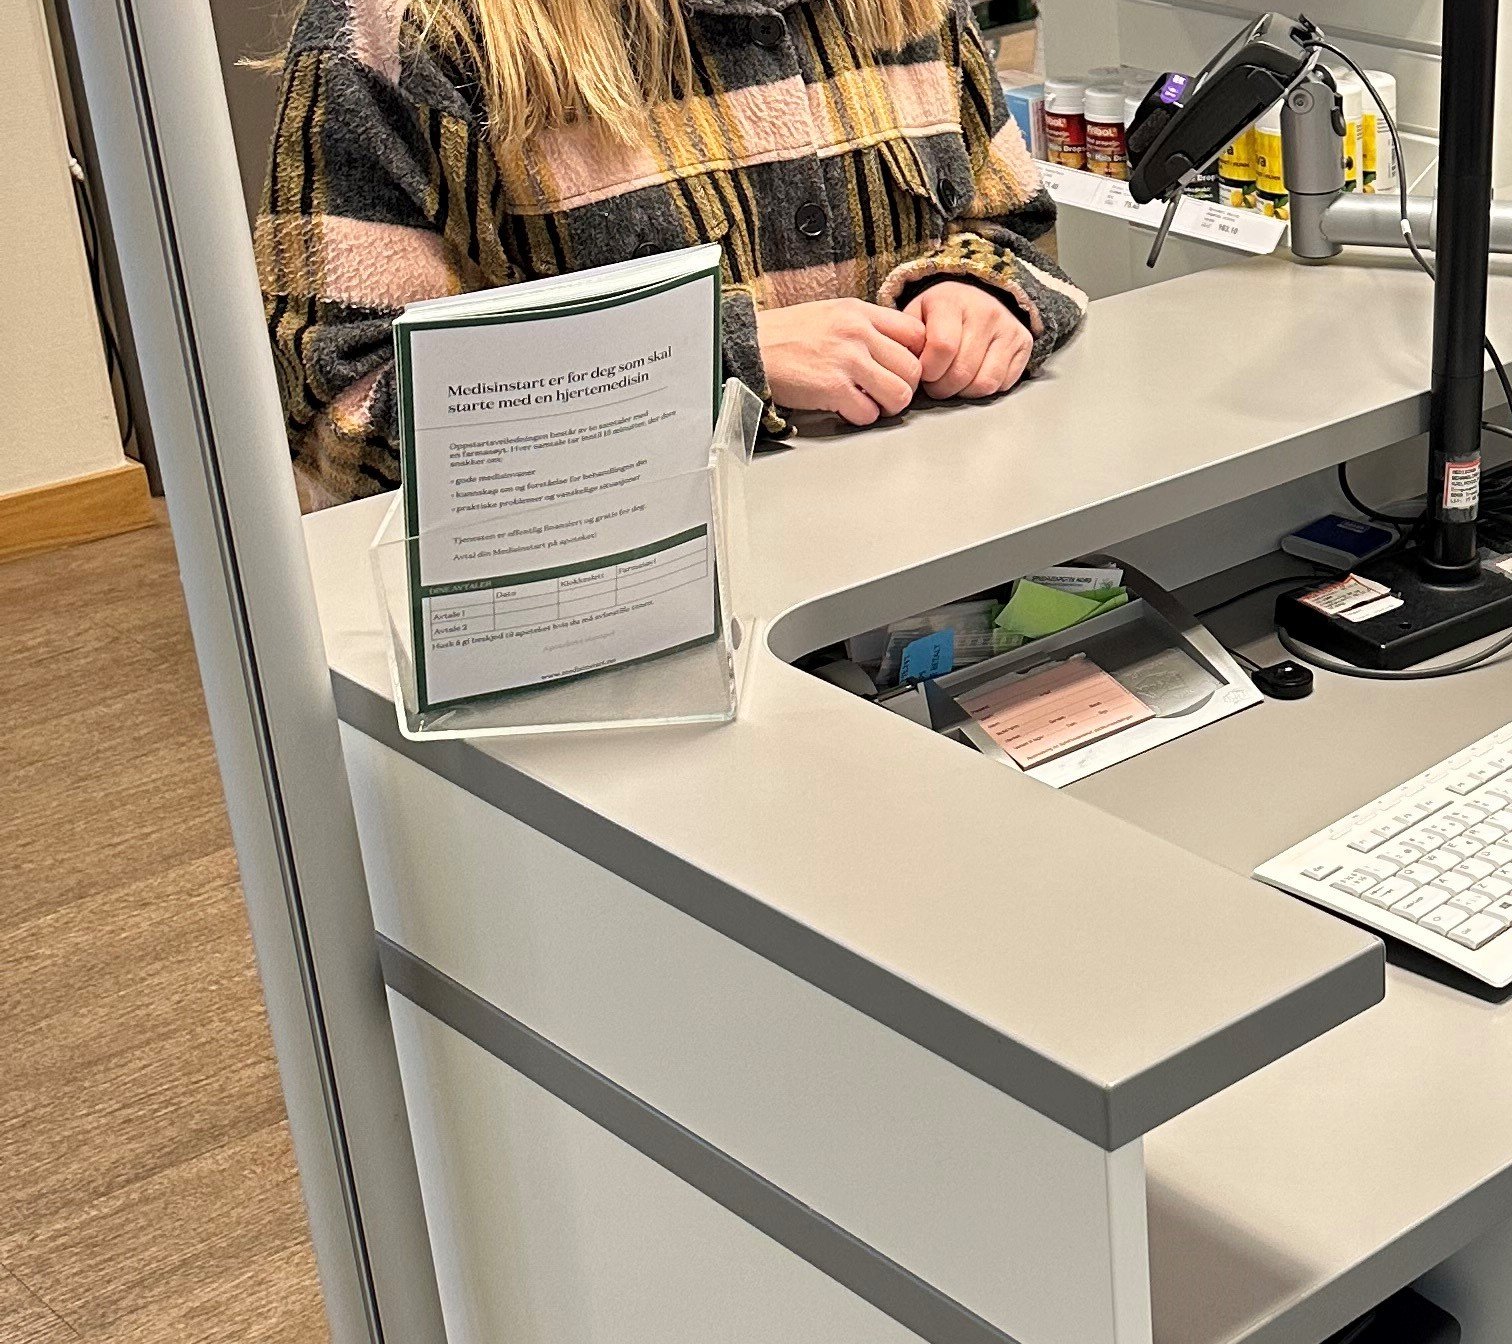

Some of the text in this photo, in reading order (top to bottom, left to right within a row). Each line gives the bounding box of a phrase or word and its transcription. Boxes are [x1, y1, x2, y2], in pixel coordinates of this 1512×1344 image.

[447, 346, 672, 398] Medisinstart er for deg som skal
[447, 372, 649, 414] starte med en hjertemedisin
[633, 410, 649, 421] med
[455, 476, 477, 485] gode
[569, 475, 581, 483] for
[544, 493, 555, 501] og
[619, 508, 630, 516] for
[477, 550, 490, 558] din
[547, 540, 558, 549] på
[433, 611, 460, 620] Avtale
[434, 625, 461, 635] Avtale
